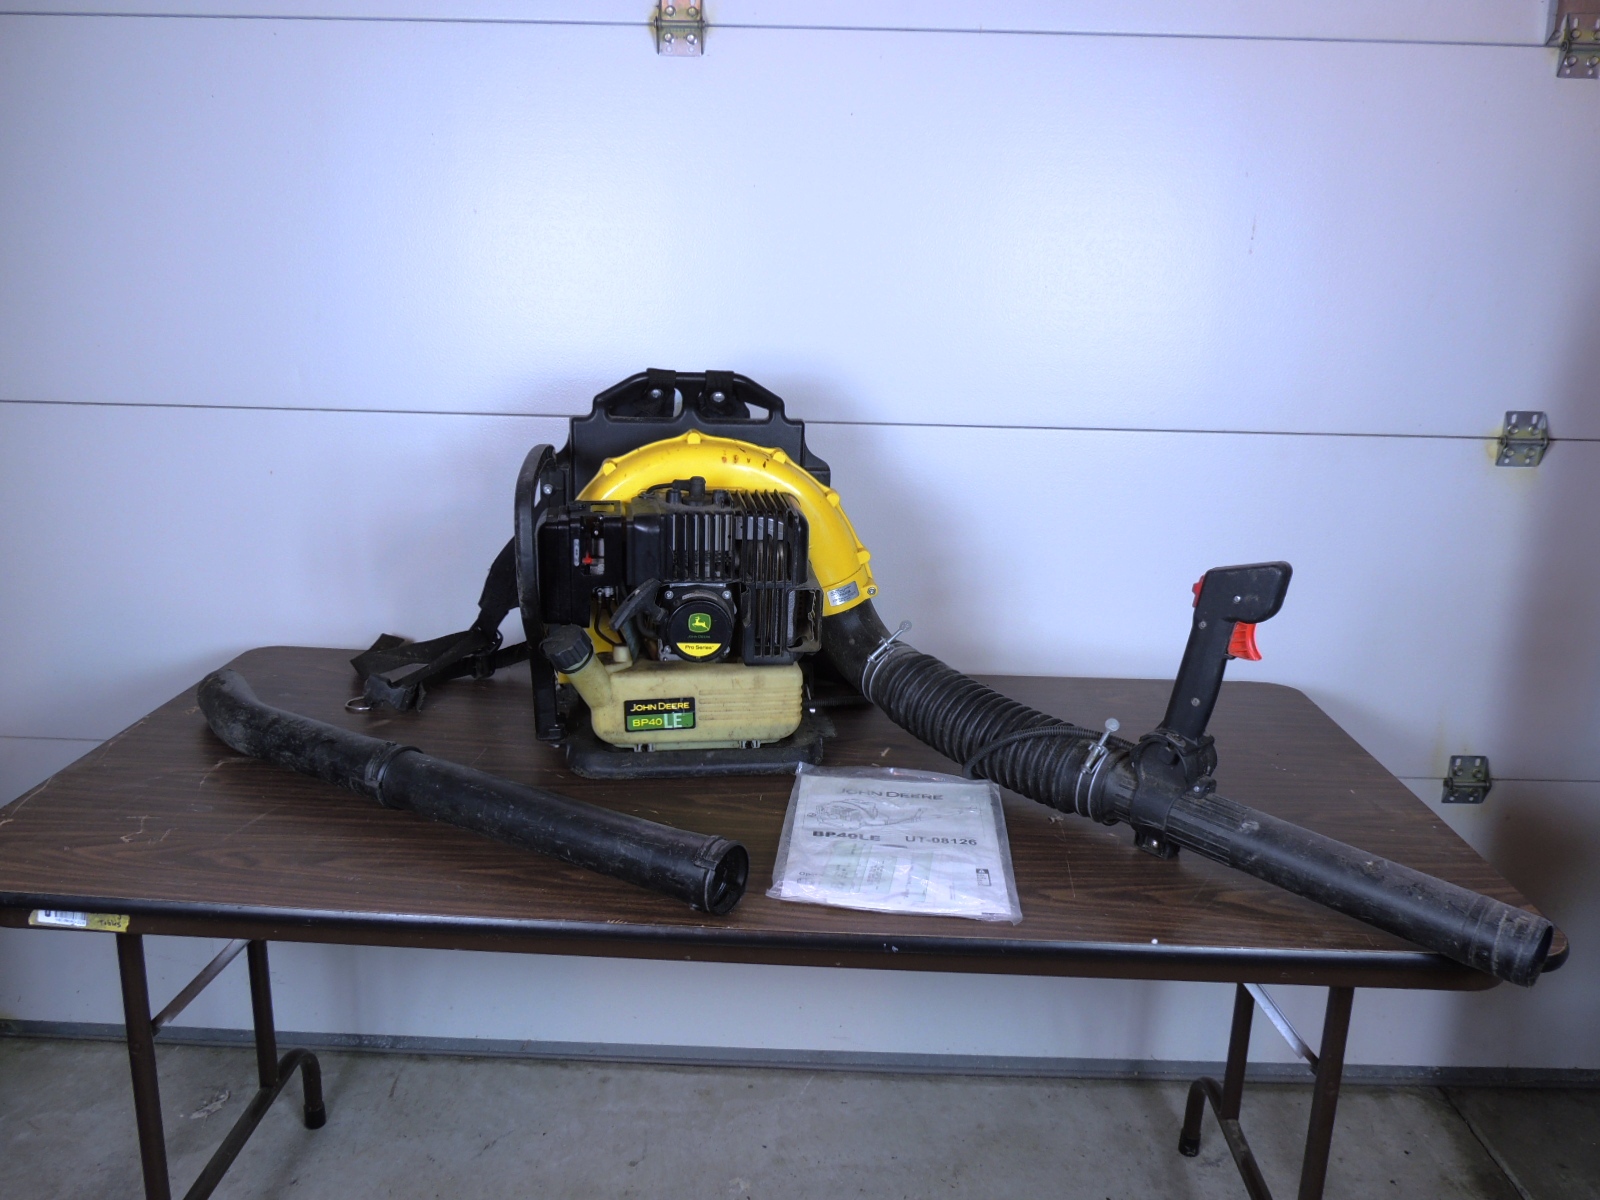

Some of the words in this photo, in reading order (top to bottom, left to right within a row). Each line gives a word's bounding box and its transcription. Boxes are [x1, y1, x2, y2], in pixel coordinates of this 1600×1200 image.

[630, 703, 657, 712] JOHN
[658, 702, 690, 711] DEERE
[841, 788, 883, 797] JOHN
[886, 791, 944, 801] DEERE
[812, 831, 881, 842] BP40LE
[905, 835, 978, 846] UT-08126
